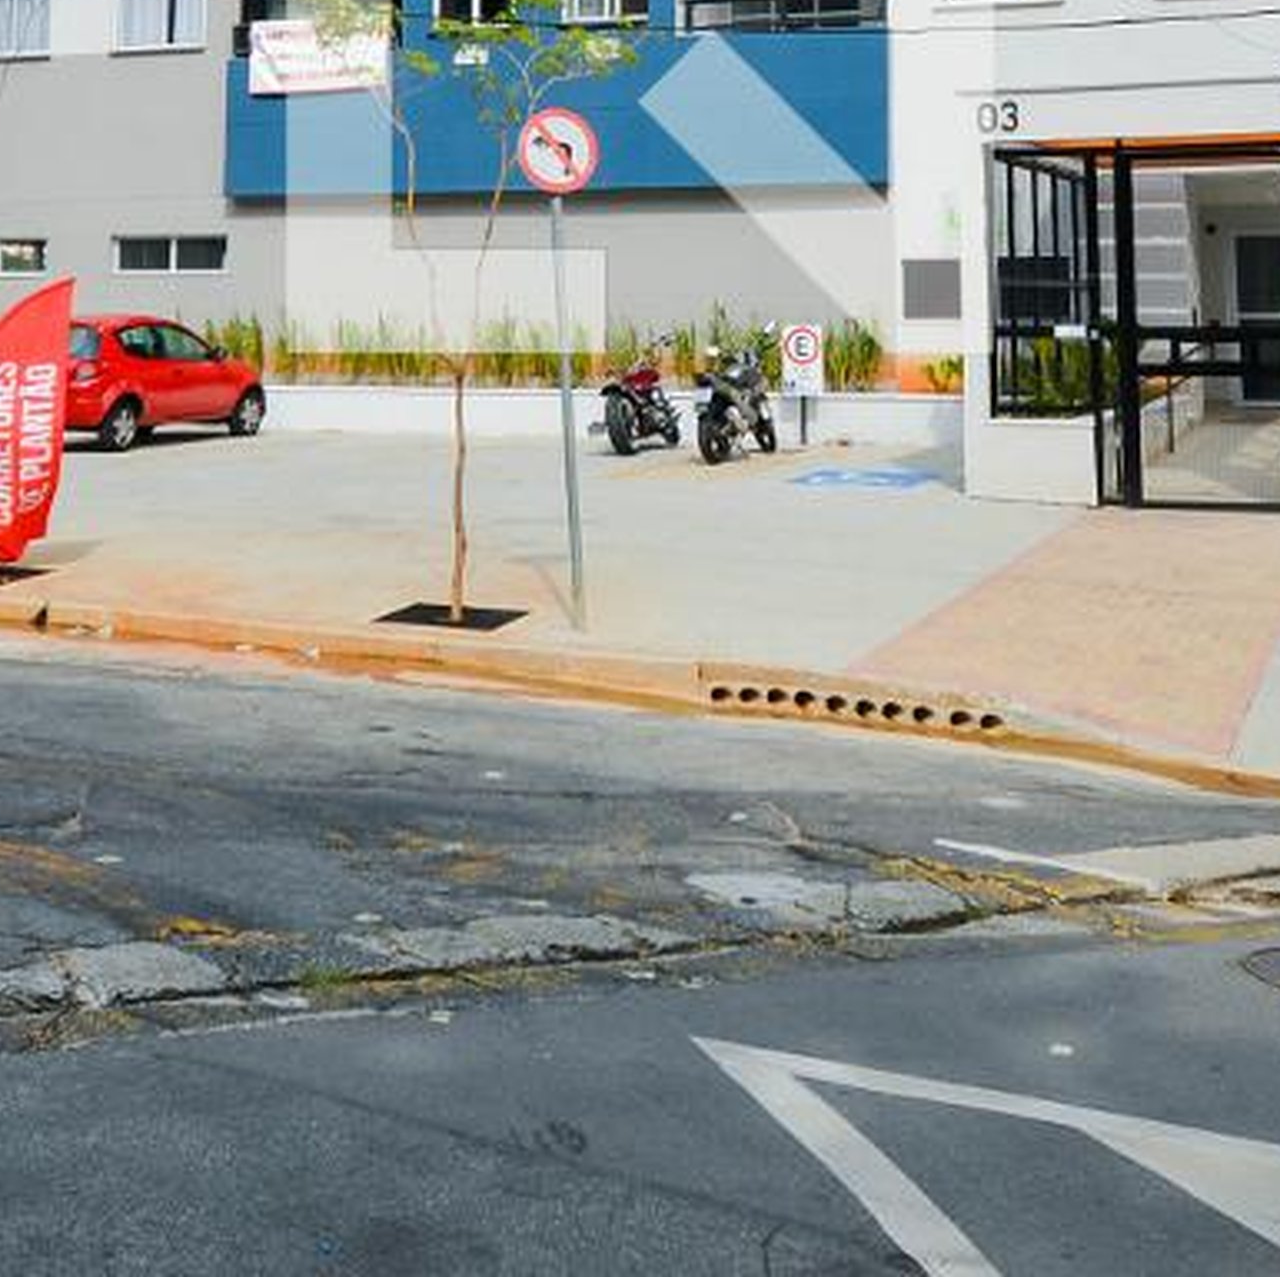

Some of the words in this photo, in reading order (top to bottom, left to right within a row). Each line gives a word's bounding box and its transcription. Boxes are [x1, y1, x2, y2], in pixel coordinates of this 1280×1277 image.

[977, 101, 1019, 134] 03
[794, 335, 810, 357] E
[19, 363, 57, 481] PLANTÃO
